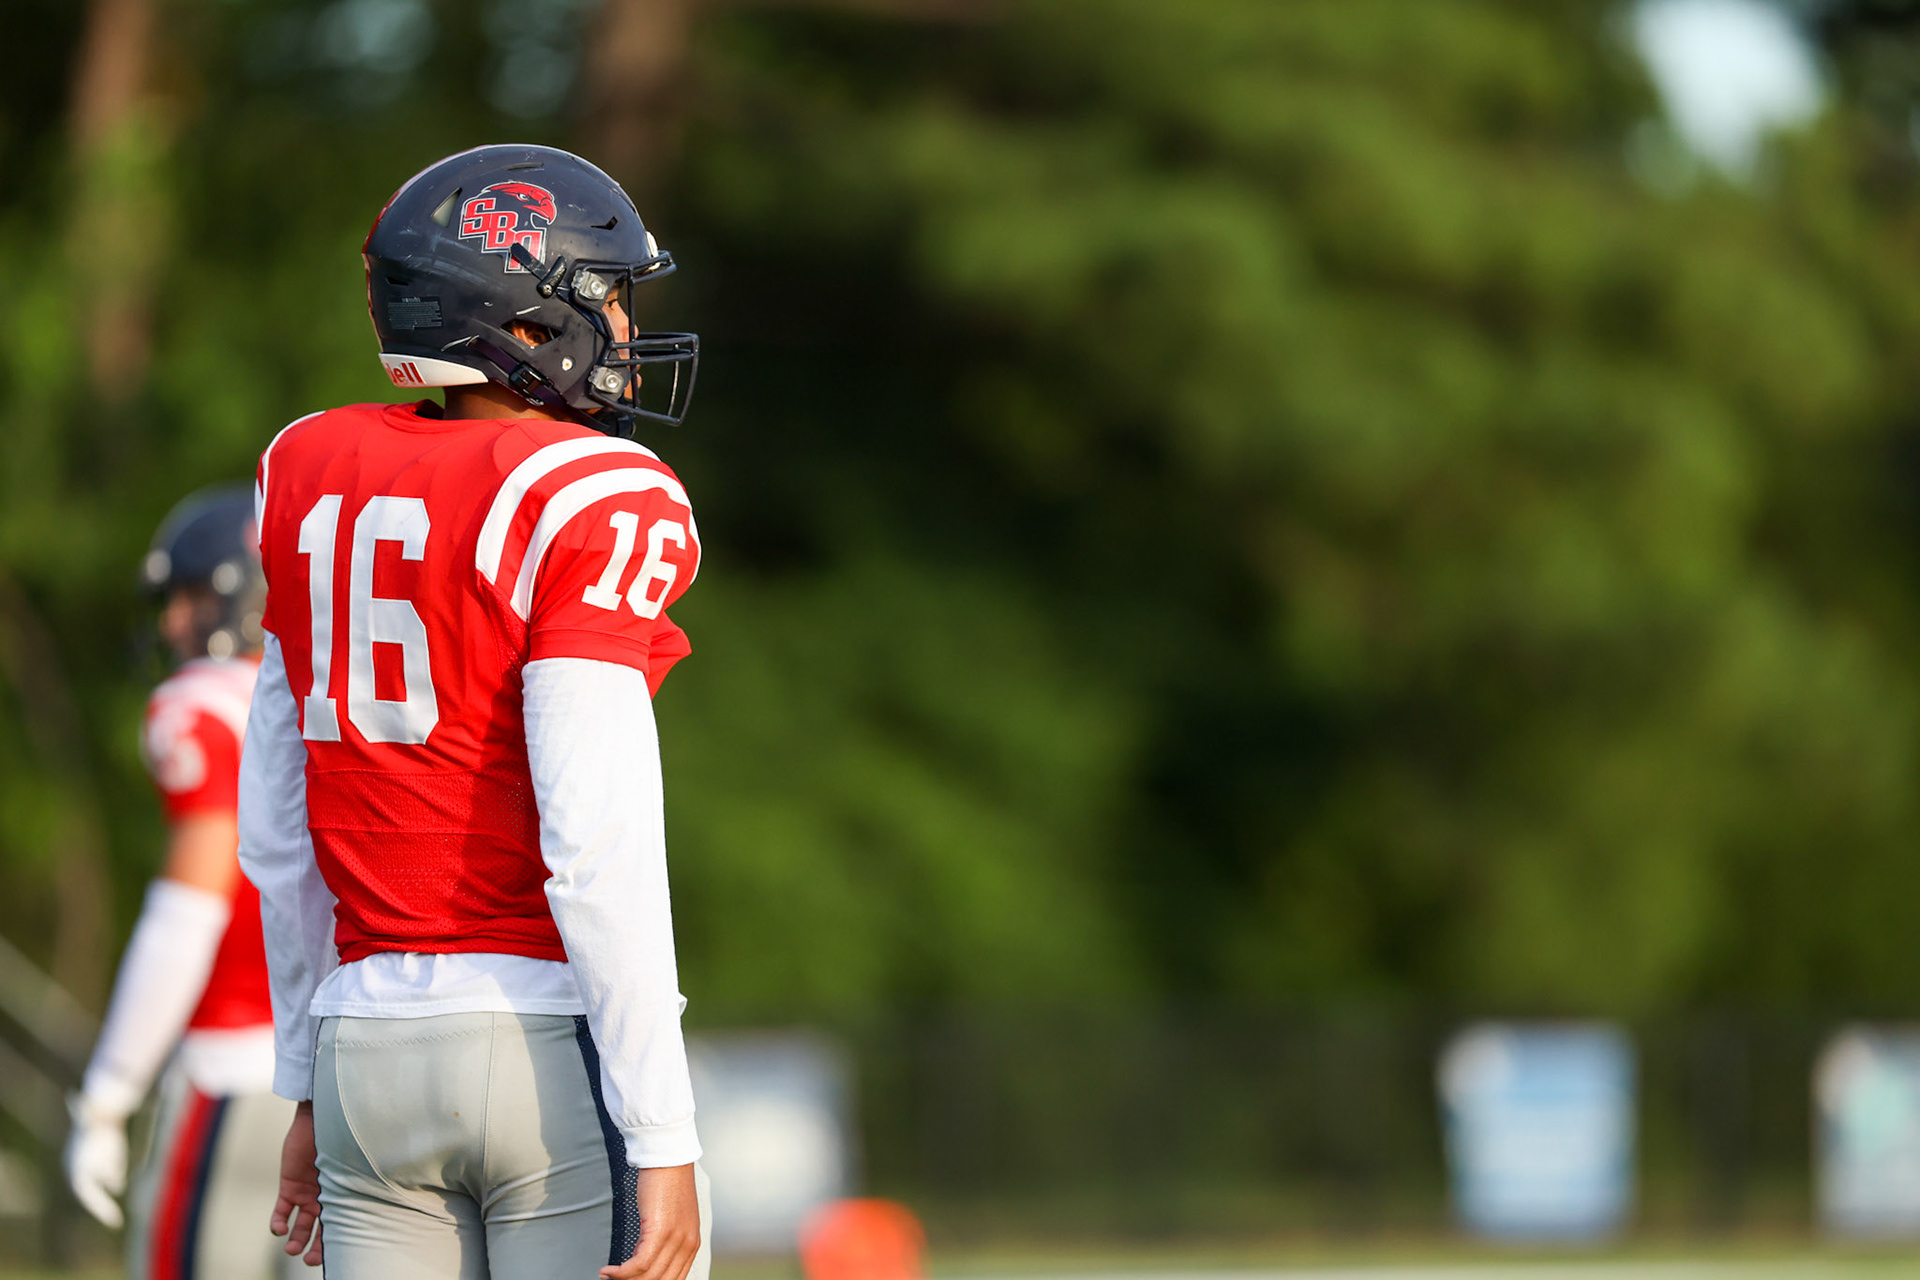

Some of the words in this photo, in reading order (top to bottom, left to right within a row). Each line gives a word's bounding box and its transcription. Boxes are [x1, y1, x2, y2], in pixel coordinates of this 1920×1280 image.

[461, 197, 544, 271] SBA
[297, 494, 439, 745] 16
[581, 510, 686, 620] 16
